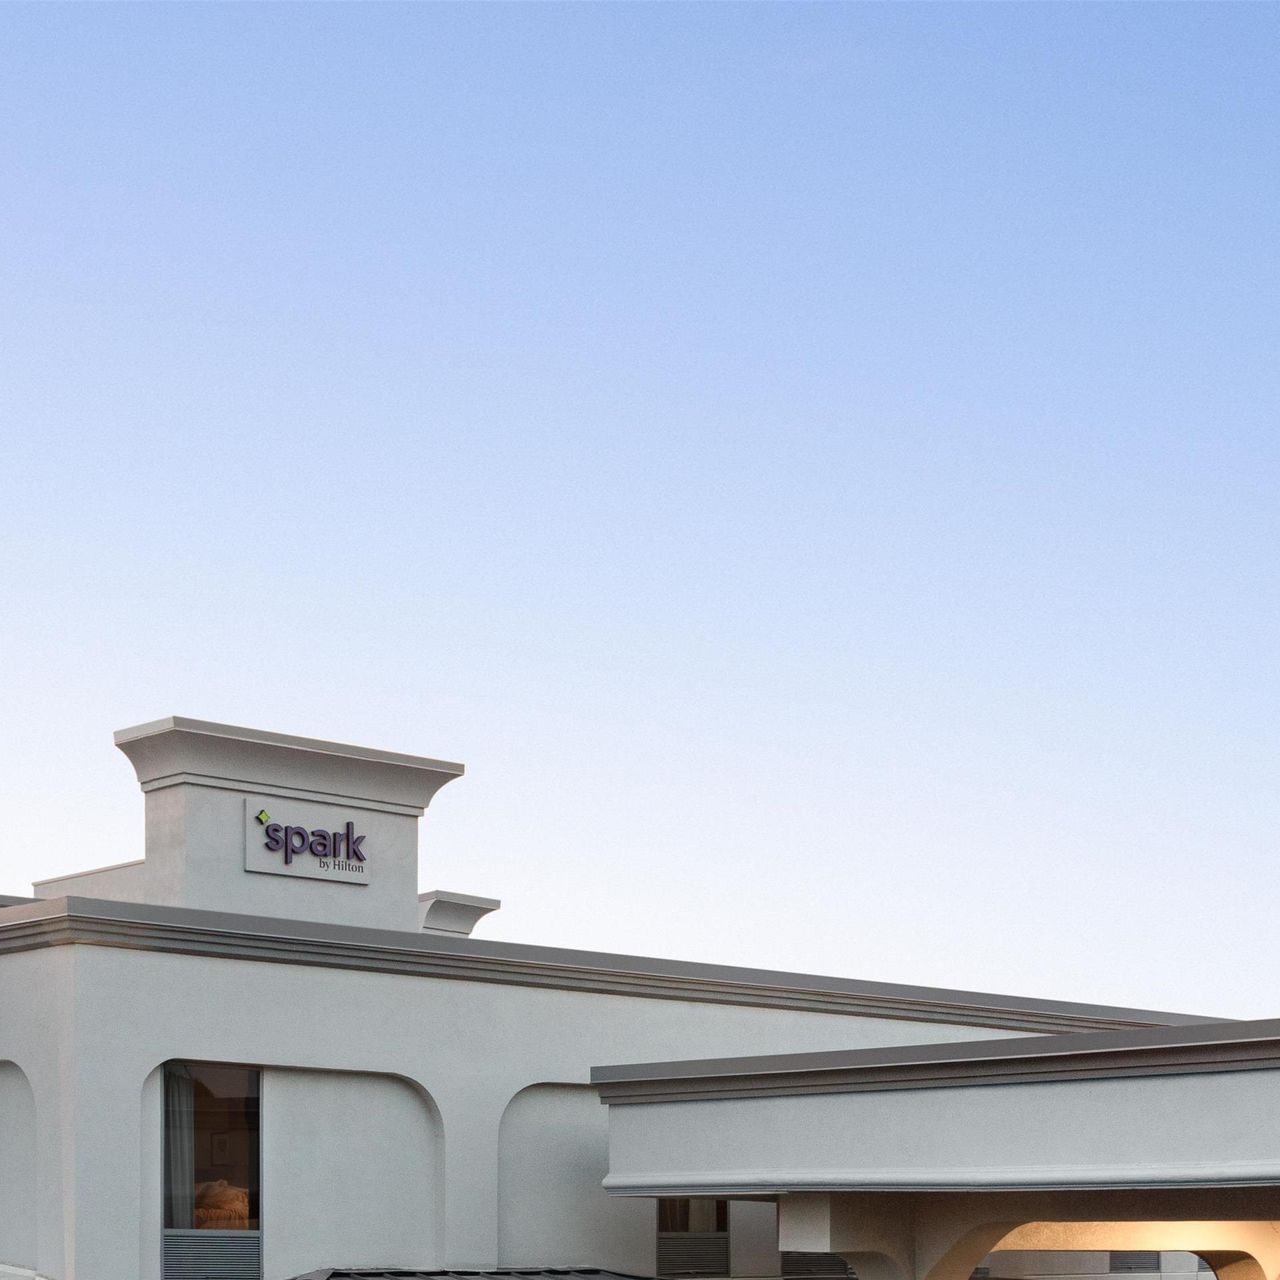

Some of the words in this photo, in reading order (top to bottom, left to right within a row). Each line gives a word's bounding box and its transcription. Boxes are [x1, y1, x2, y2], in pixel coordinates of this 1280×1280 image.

[265, 821, 367, 865] spark
[319, 857, 331, 871] by
[333, 859, 364, 873] Hilton
